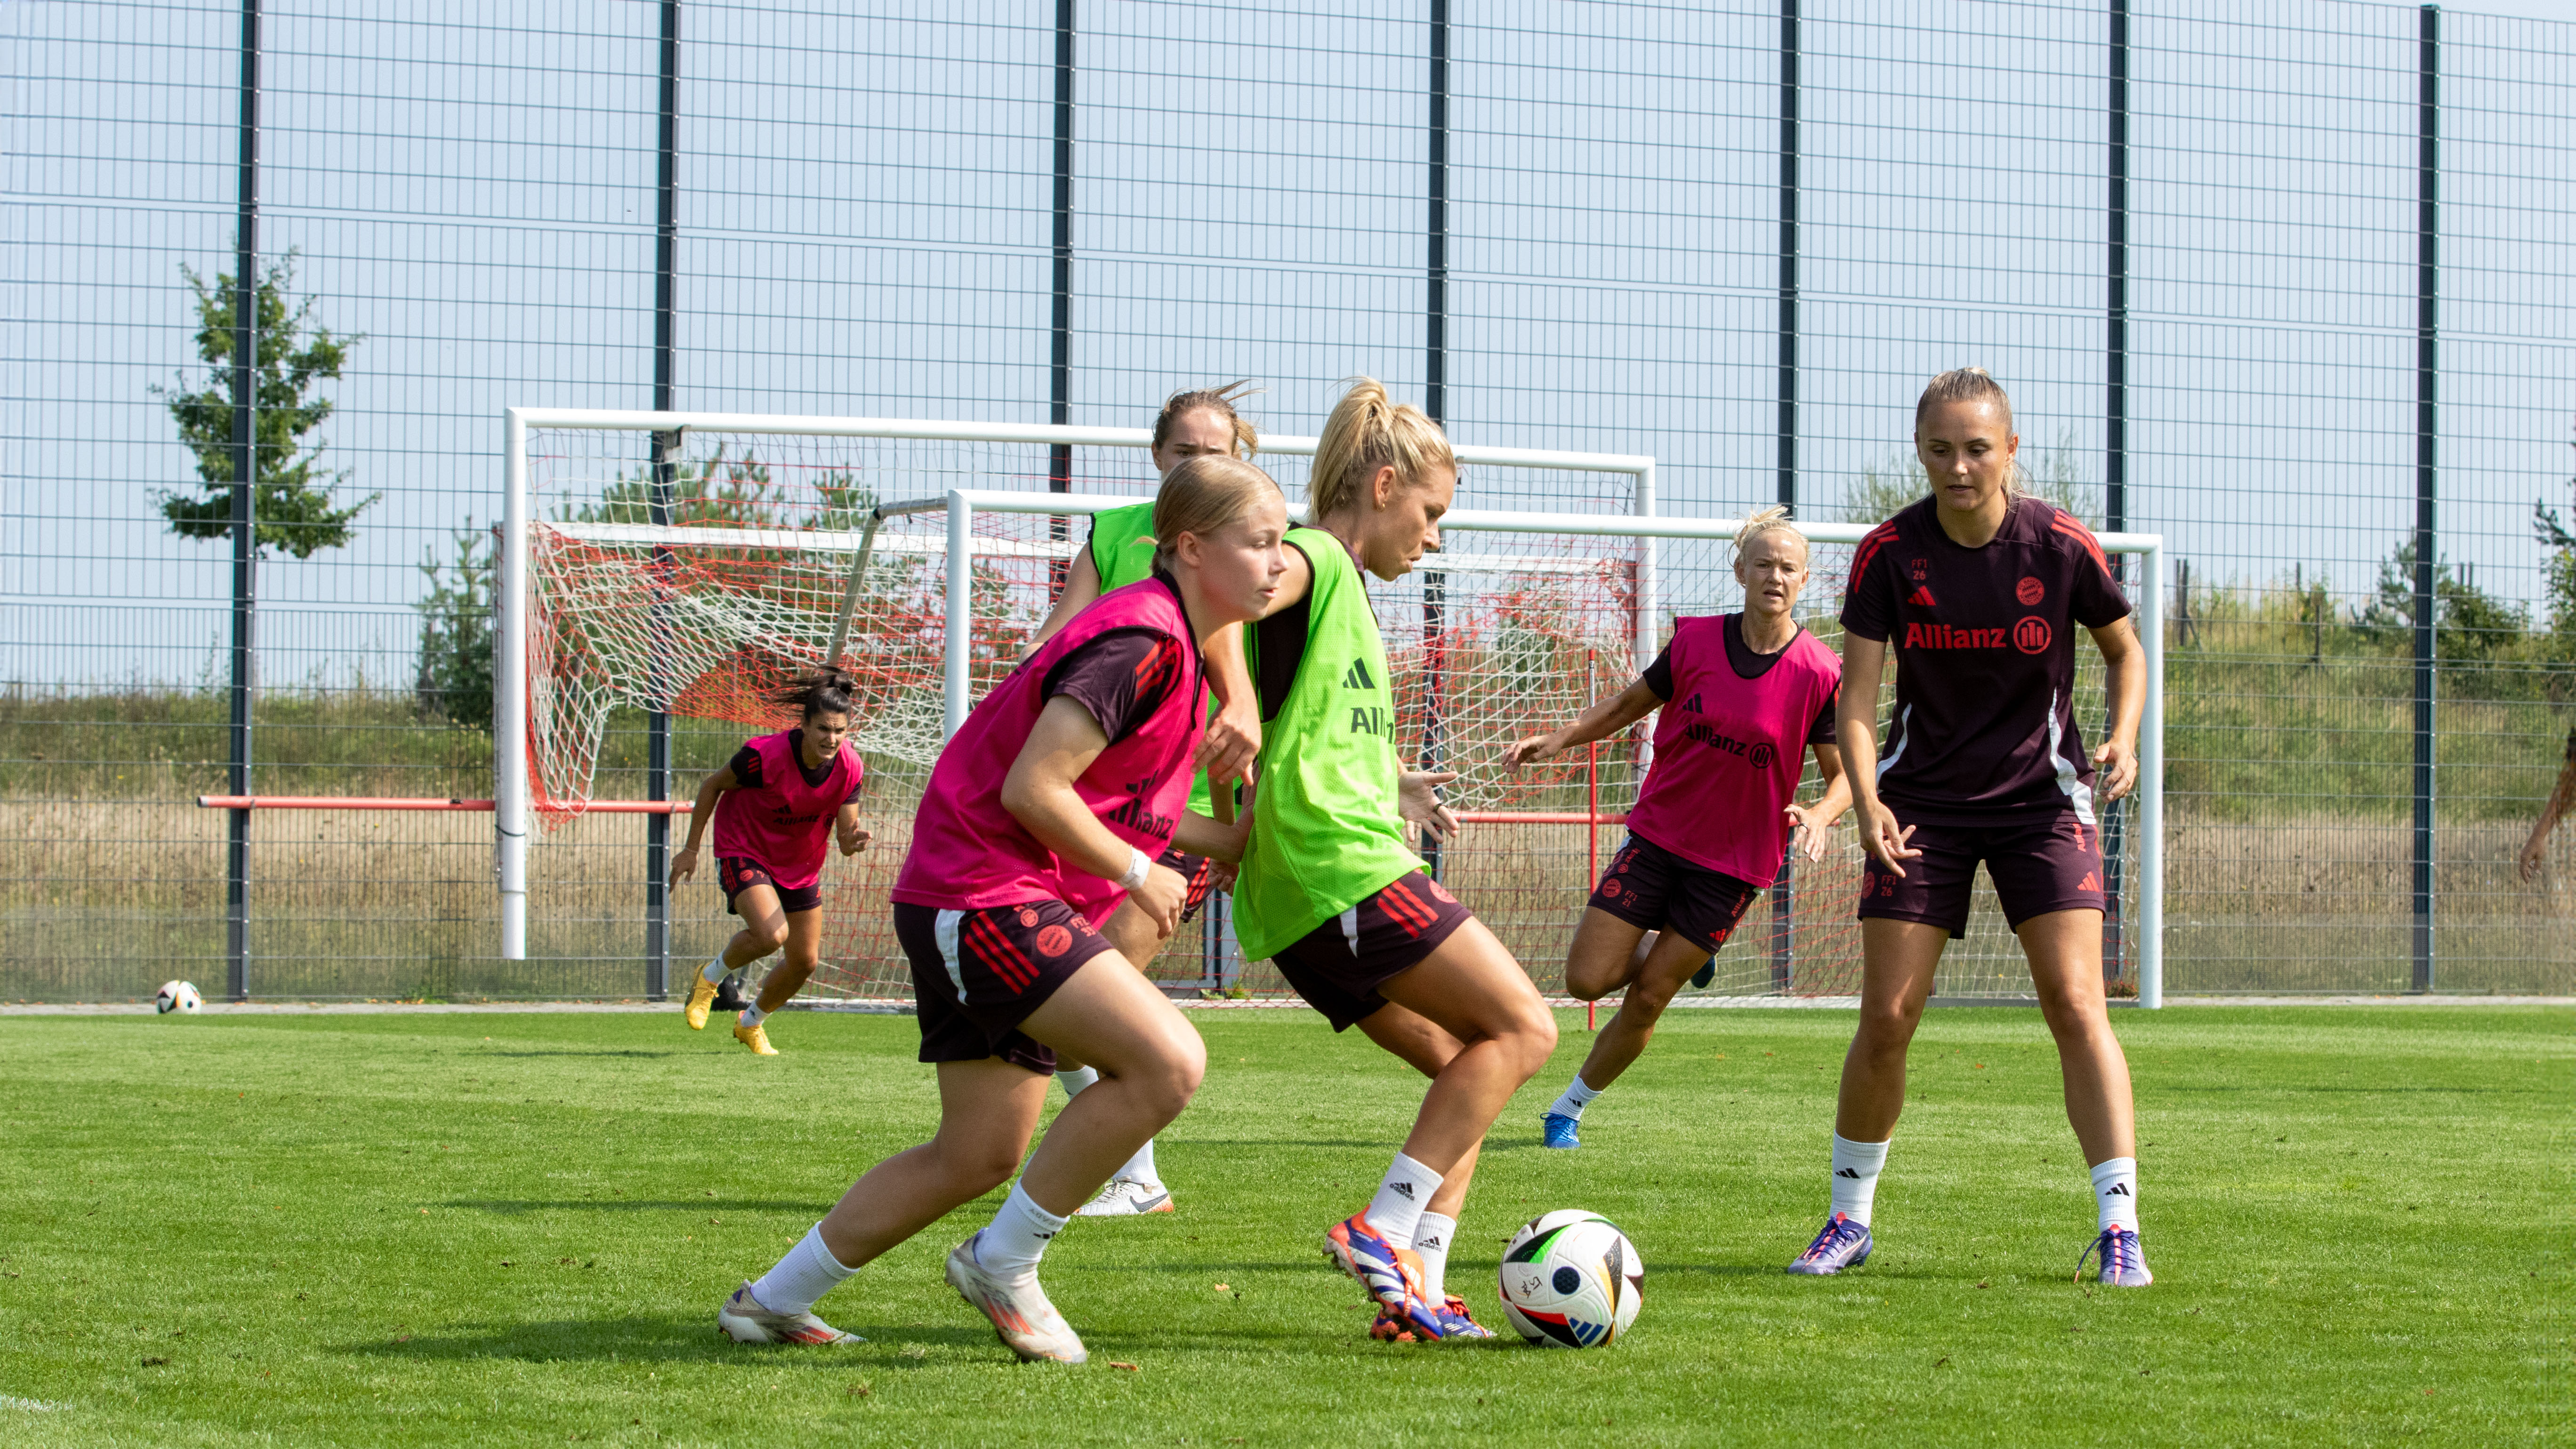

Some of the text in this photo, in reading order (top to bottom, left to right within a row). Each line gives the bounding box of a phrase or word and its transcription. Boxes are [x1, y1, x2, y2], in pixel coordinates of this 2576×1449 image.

[1913, 570, 1926, 580] 26
[1904, 622, 2007, 649] Allianz
[1686, 723, 1747, 757] Allianz
[1881, 886, 1893, 896] 26
[1389, 1183, 1415, 1201] adidas
[1418, 1241, 1443, 1253] adidas
